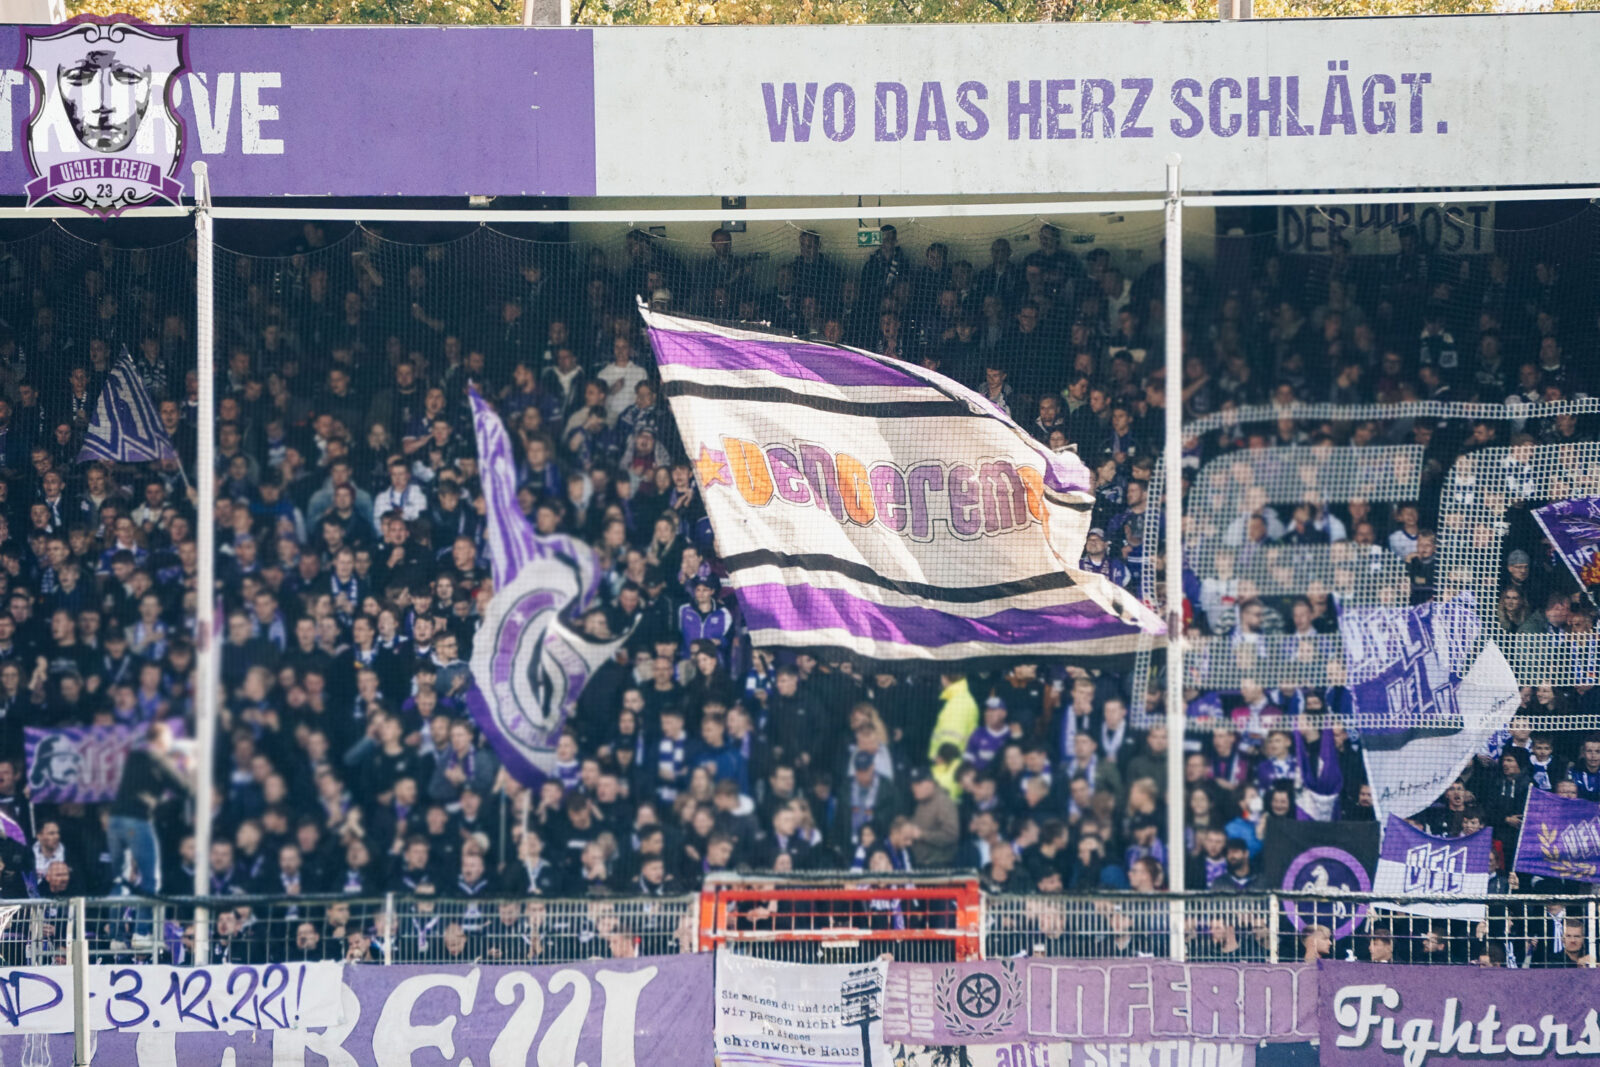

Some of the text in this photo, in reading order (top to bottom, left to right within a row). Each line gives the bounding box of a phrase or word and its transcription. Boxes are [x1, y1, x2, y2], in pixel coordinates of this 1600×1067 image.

[762, 60, 1448, 143] WO DAS HERZ SCHLÄGT.
[1283, 205, 1351, 251] DER
[1420, 205, 1489, 251] OST
[105, 963, 307, 1030] 3.12.22!
[721, 990, 739, 1000] Sie
[742, 994, 779, 1009] meinen
[722, 1007, 837, 1030] wir passen nicht
[723, 1034, 860, 1057] ehrenwerte Haus
